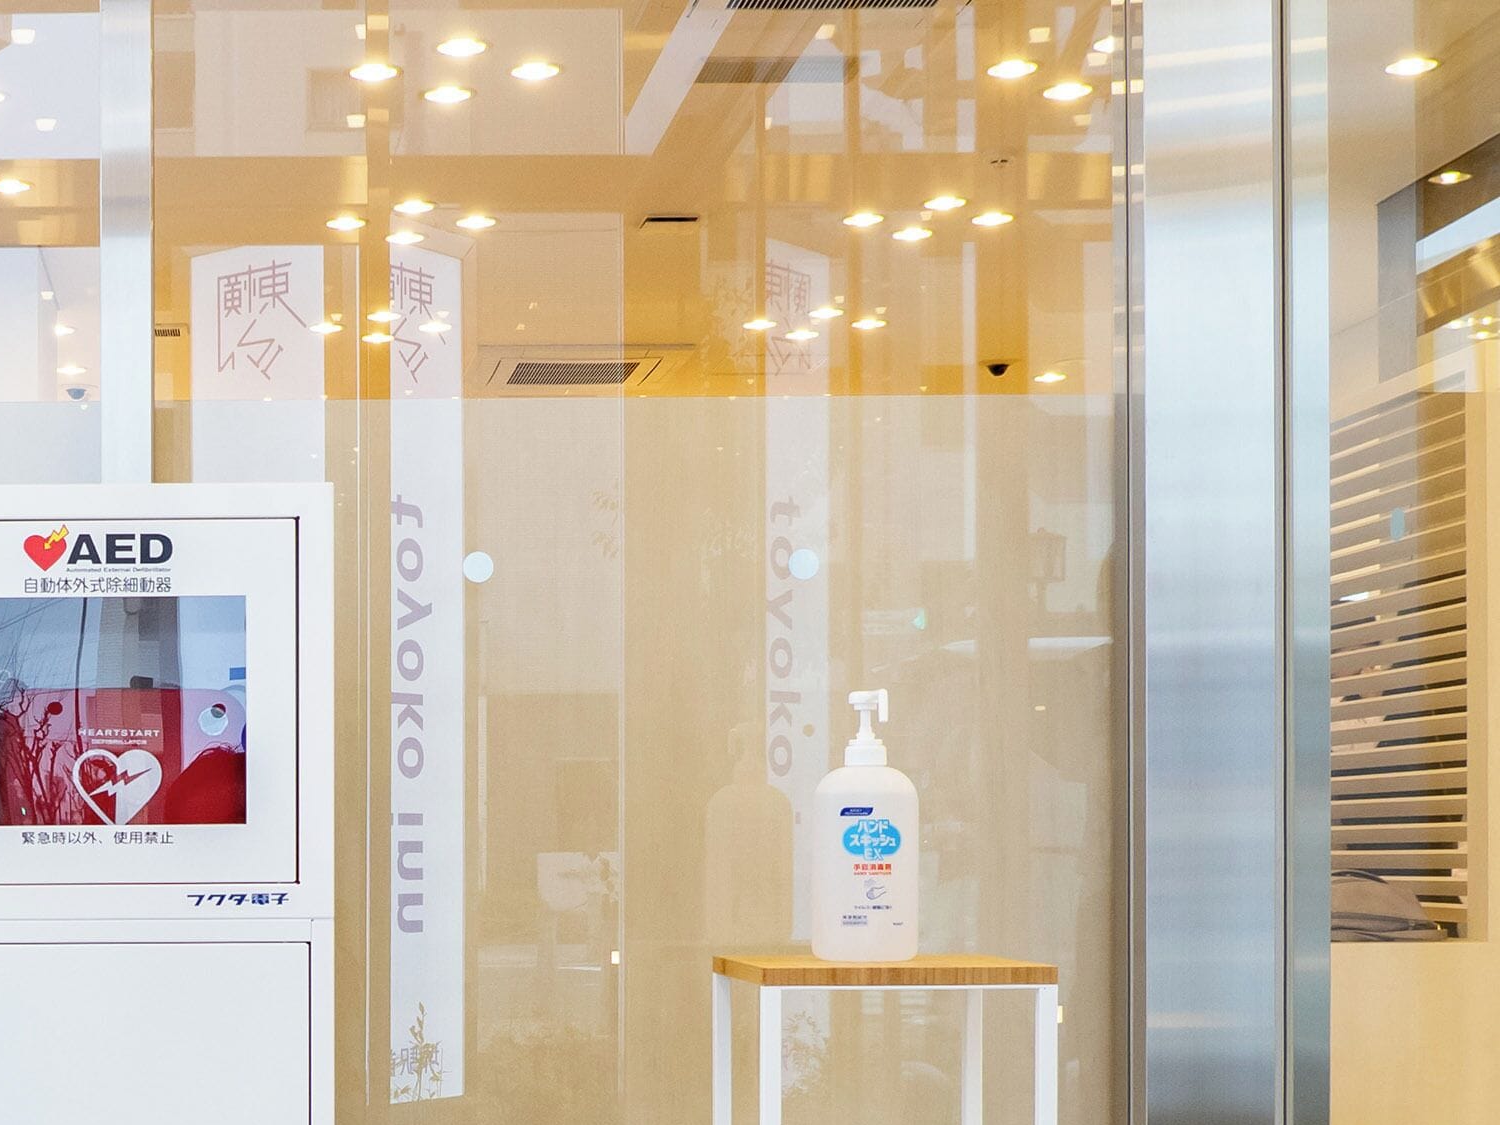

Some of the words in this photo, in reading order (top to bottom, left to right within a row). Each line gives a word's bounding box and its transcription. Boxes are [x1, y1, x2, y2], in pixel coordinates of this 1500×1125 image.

[67, 533, 173, 565] AED
[24, 577, 172, 594] 自動体外式除細動器
[78, 728, 160, 743] HEARTSTART
[857, 820, 889, 834] ハンド
[864, 847, 884, 860] EX
